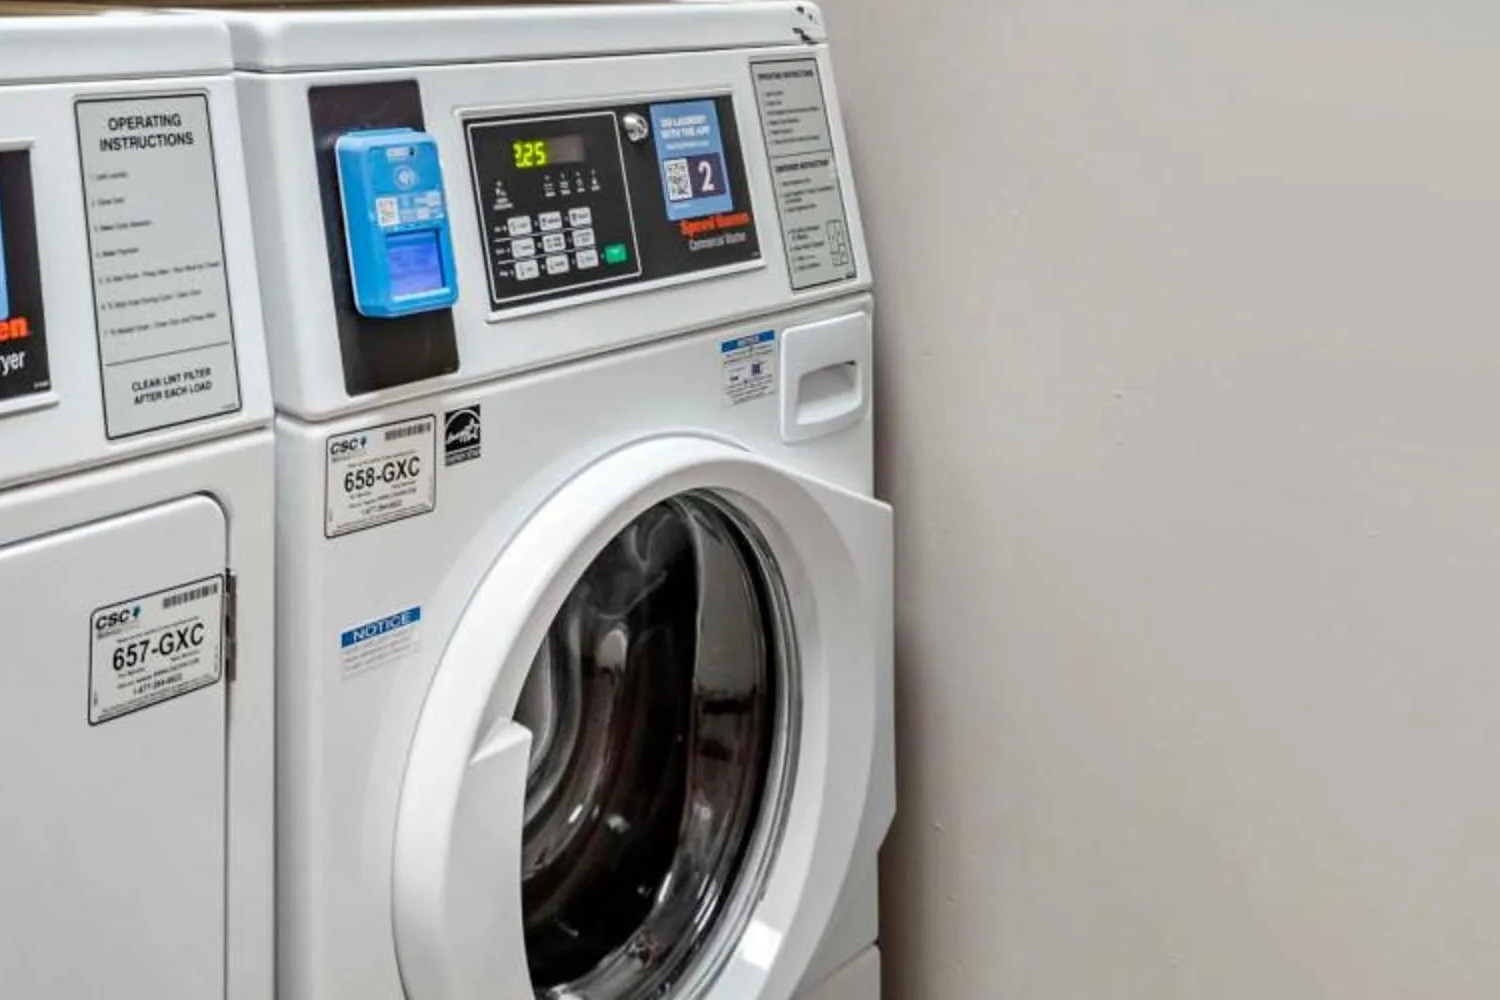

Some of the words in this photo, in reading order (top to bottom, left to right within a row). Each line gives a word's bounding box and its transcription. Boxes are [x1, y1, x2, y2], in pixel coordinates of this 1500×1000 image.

[108, 113, 181, 131] OPERATING
[100, 132, 193, 151] INSTRUCTIONS
[698, 161, 715, 192] 2
[131, 379, 161, 391] CLEAR
[163, 373, 181, 385] LINT
[183, 367, 211, 380] FILTER
[134, 391, 162, 404] AFTER
[164, 386, 187, 398] EACH
[189, 381, 212, 393] LOAD
[330, 439, 358, 455] CSC
[344, 456, 420, 492] 658-GXC
[95, 609, 130, 630] CSC
[353, 611, 412, 641] NOTICE
[113, 623, 204, 671] 657-GXC
